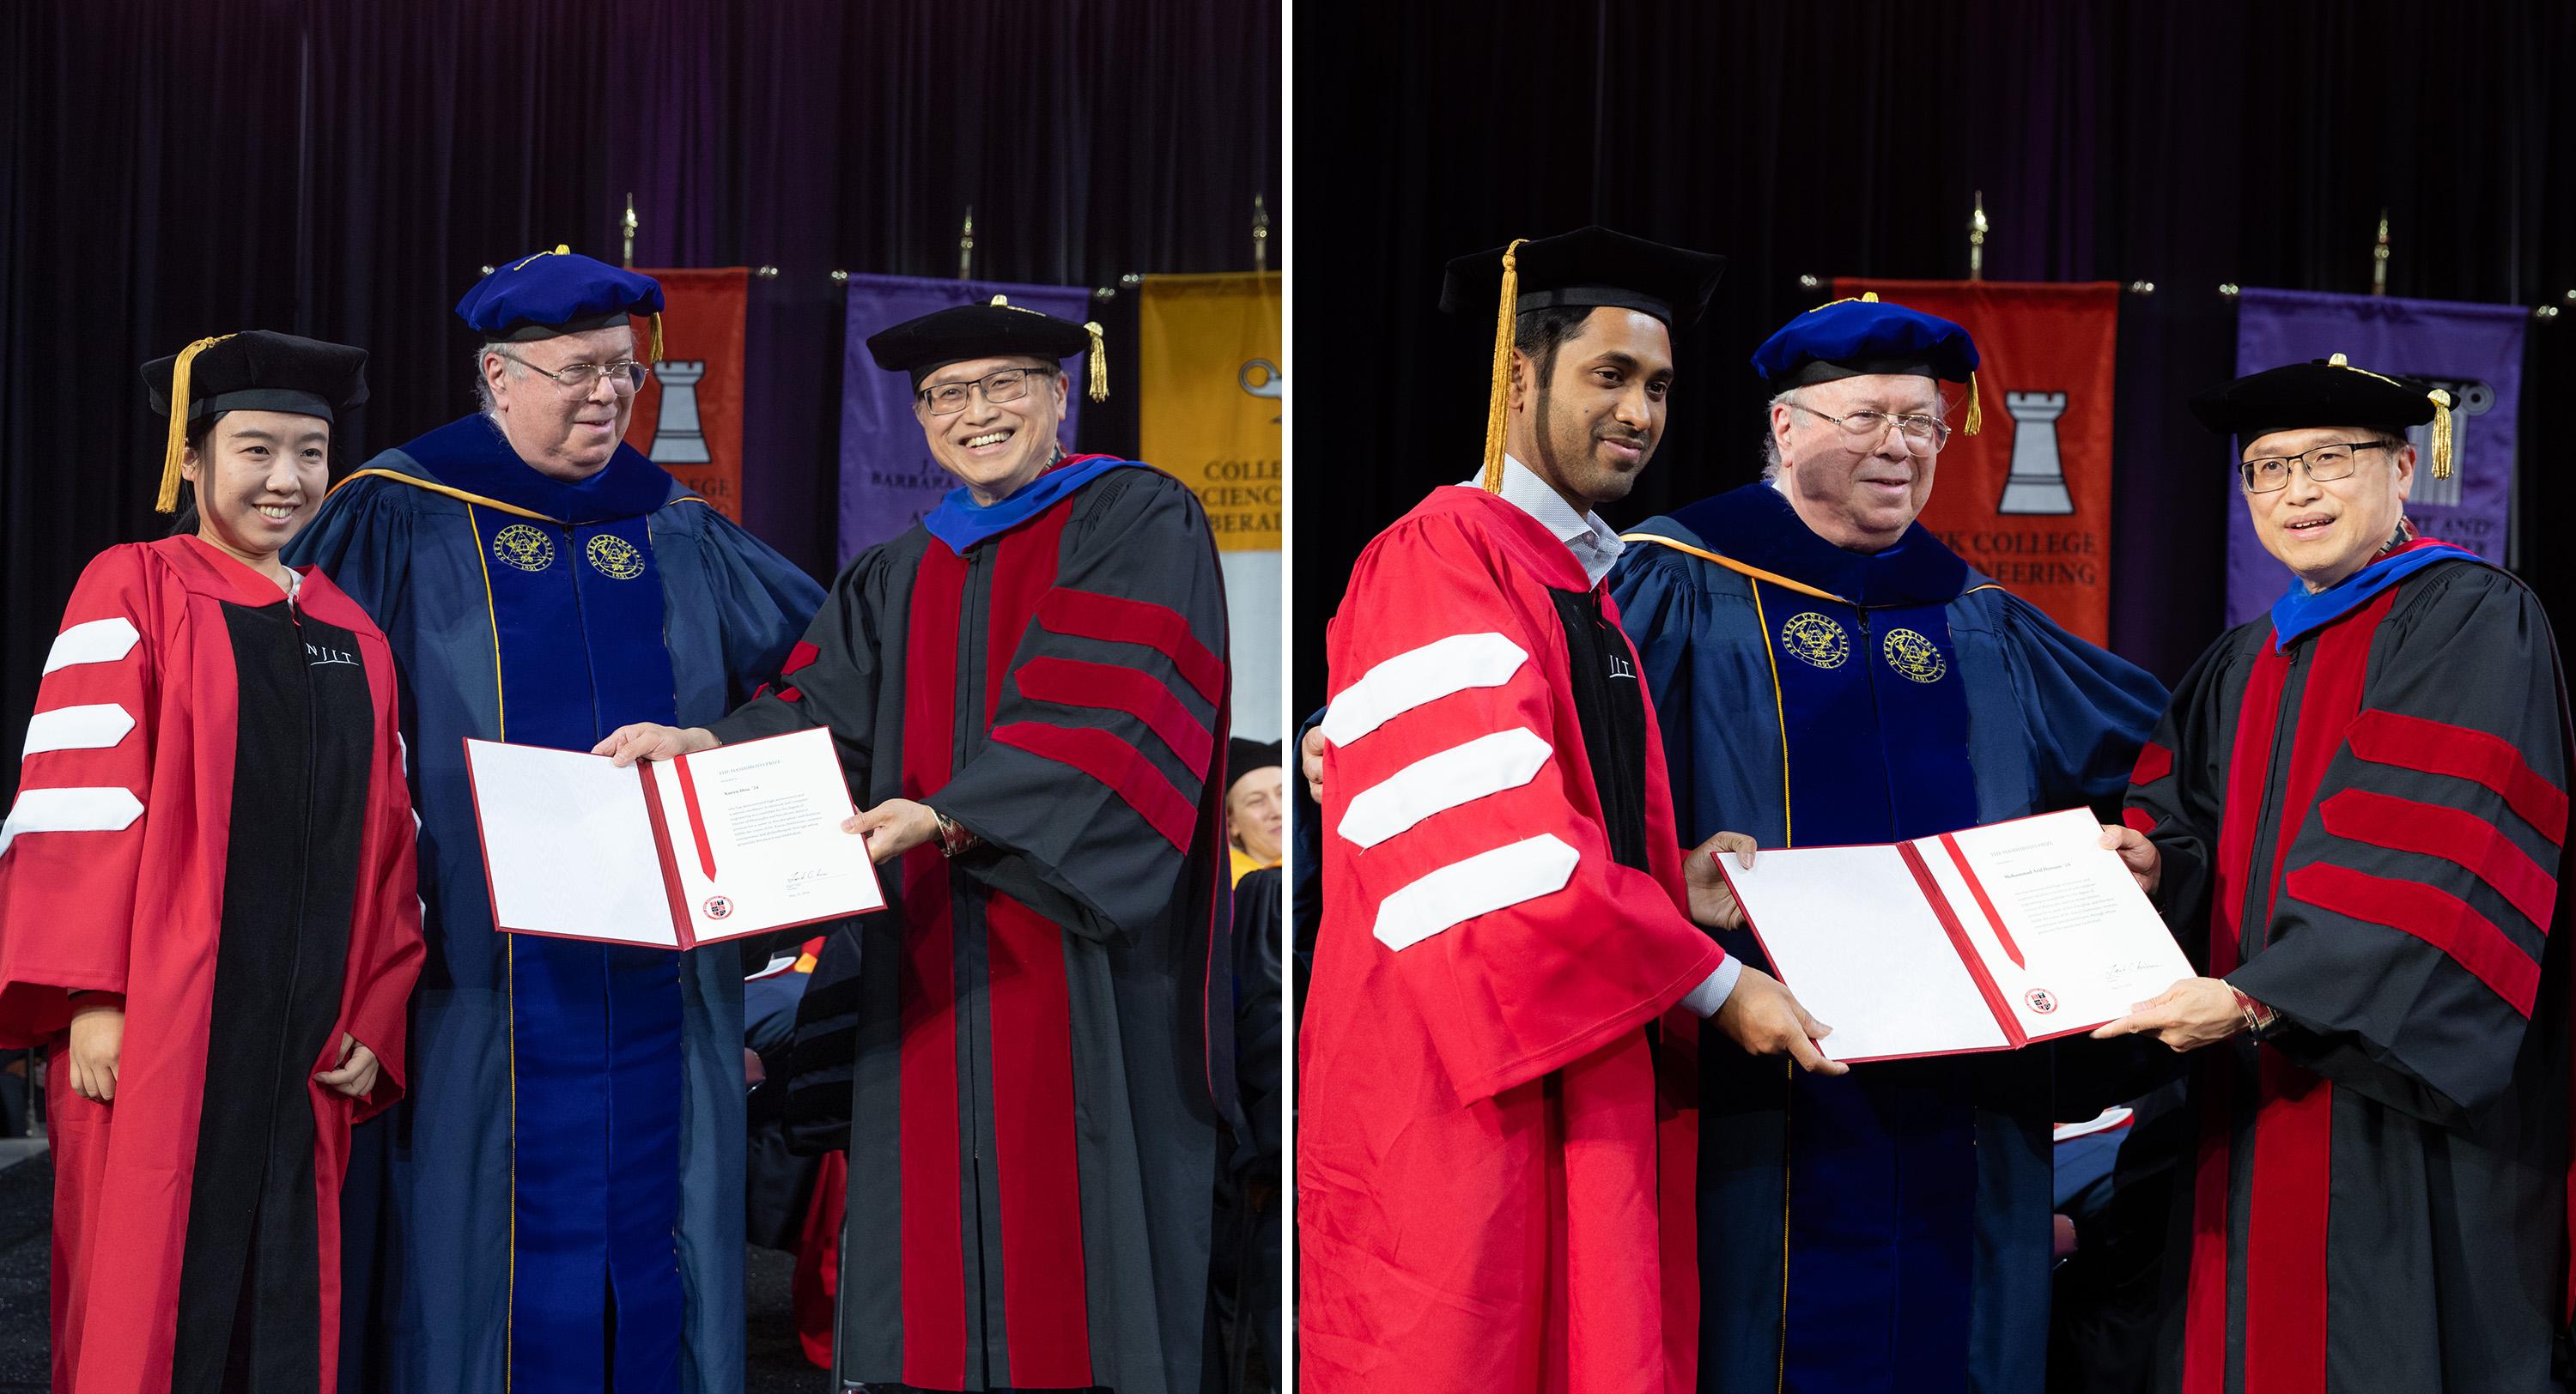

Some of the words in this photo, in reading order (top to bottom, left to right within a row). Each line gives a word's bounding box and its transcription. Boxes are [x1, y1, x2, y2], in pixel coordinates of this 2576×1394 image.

[1196, 486, 1282, 506] CIENC
[1972, 531, 2095, 554] COLLEGE
[306, 642, 352, 664] NJIT
